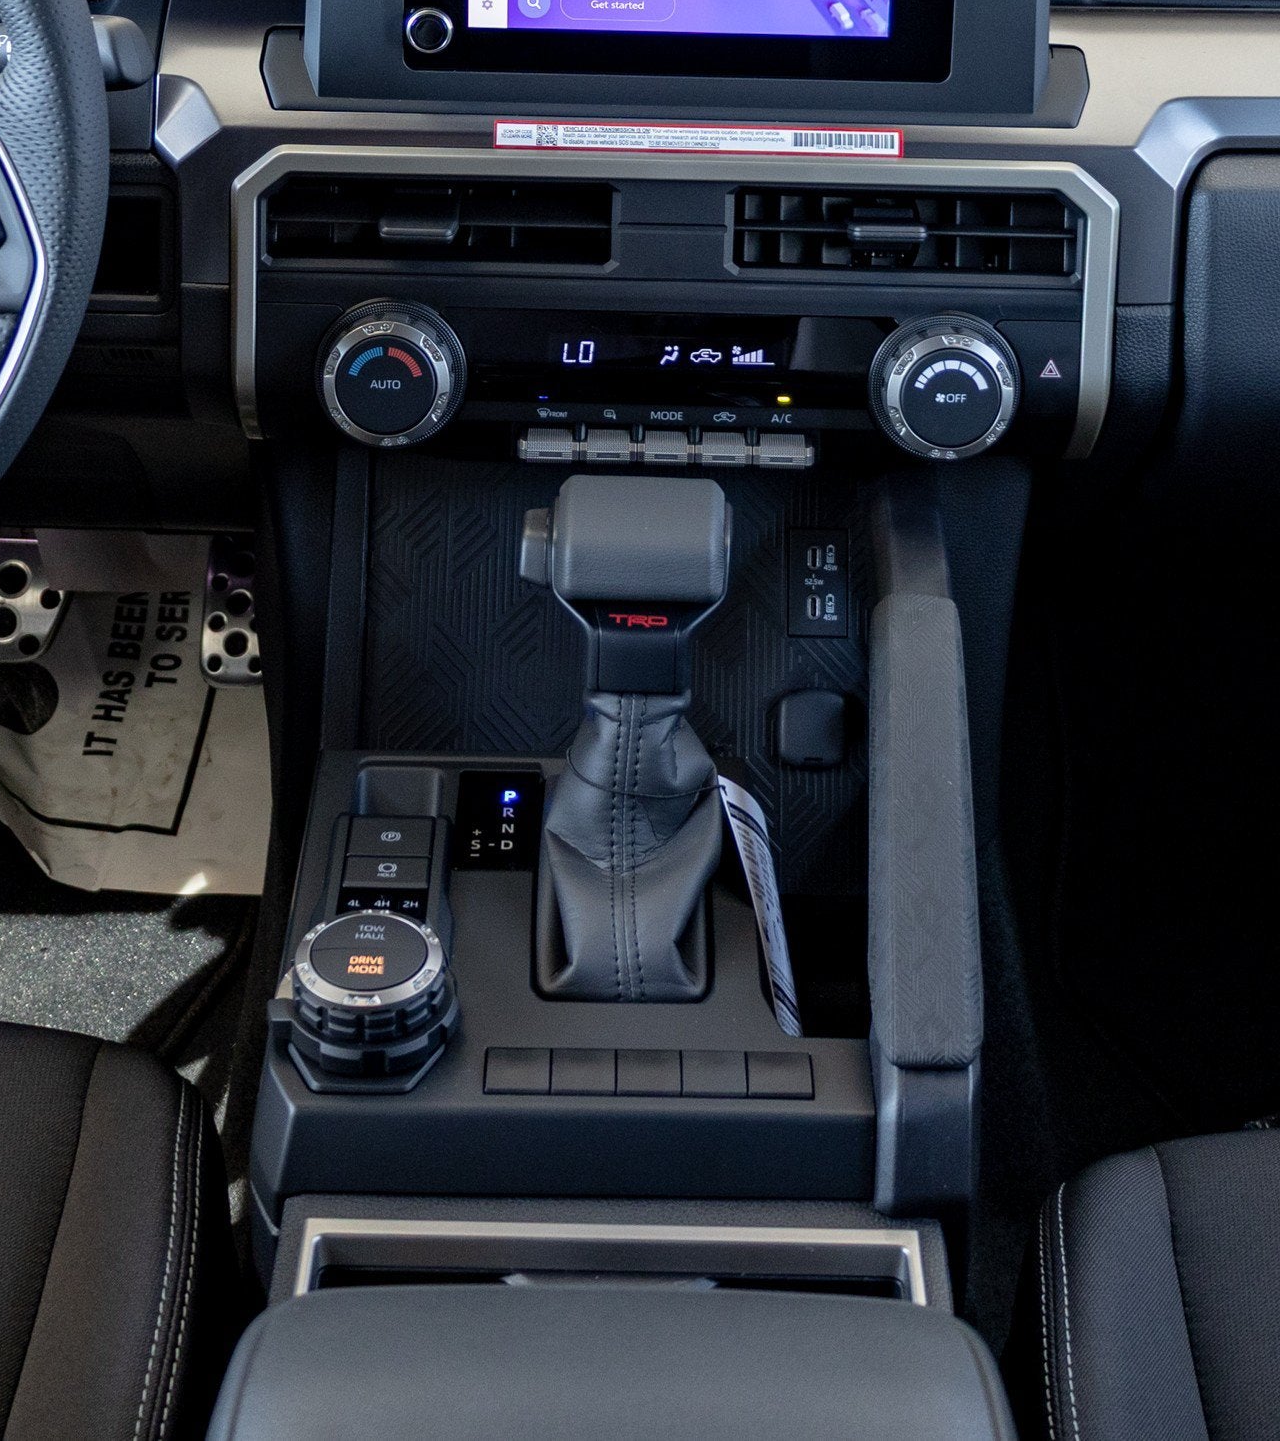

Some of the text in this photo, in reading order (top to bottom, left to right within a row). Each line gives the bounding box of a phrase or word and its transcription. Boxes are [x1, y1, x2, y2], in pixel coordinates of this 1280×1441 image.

[591, 0, 645, 10] Get started
[563, 341, 595, 363] LO
[370, 380, 401, 389] AUTO
[946, 394, 967, 403] OFF
[651, 411, 683, 421] MODE
[771, 413, 792, 424] A/C
[609, 613, 668, 627] TRD
[145, 653, 182, 688] TO
[92, 671, 136, 722] HAS
[82, 731, 118, 756] IT
[504, 791, 516, 802] P
[502, 808, 514, 818] R
[502, 824, 514, 833] N
[471, 840, 513, 850] S D
[349, 956, 384, 965] DRIVE
[348, 965, 384, 974] MODE
